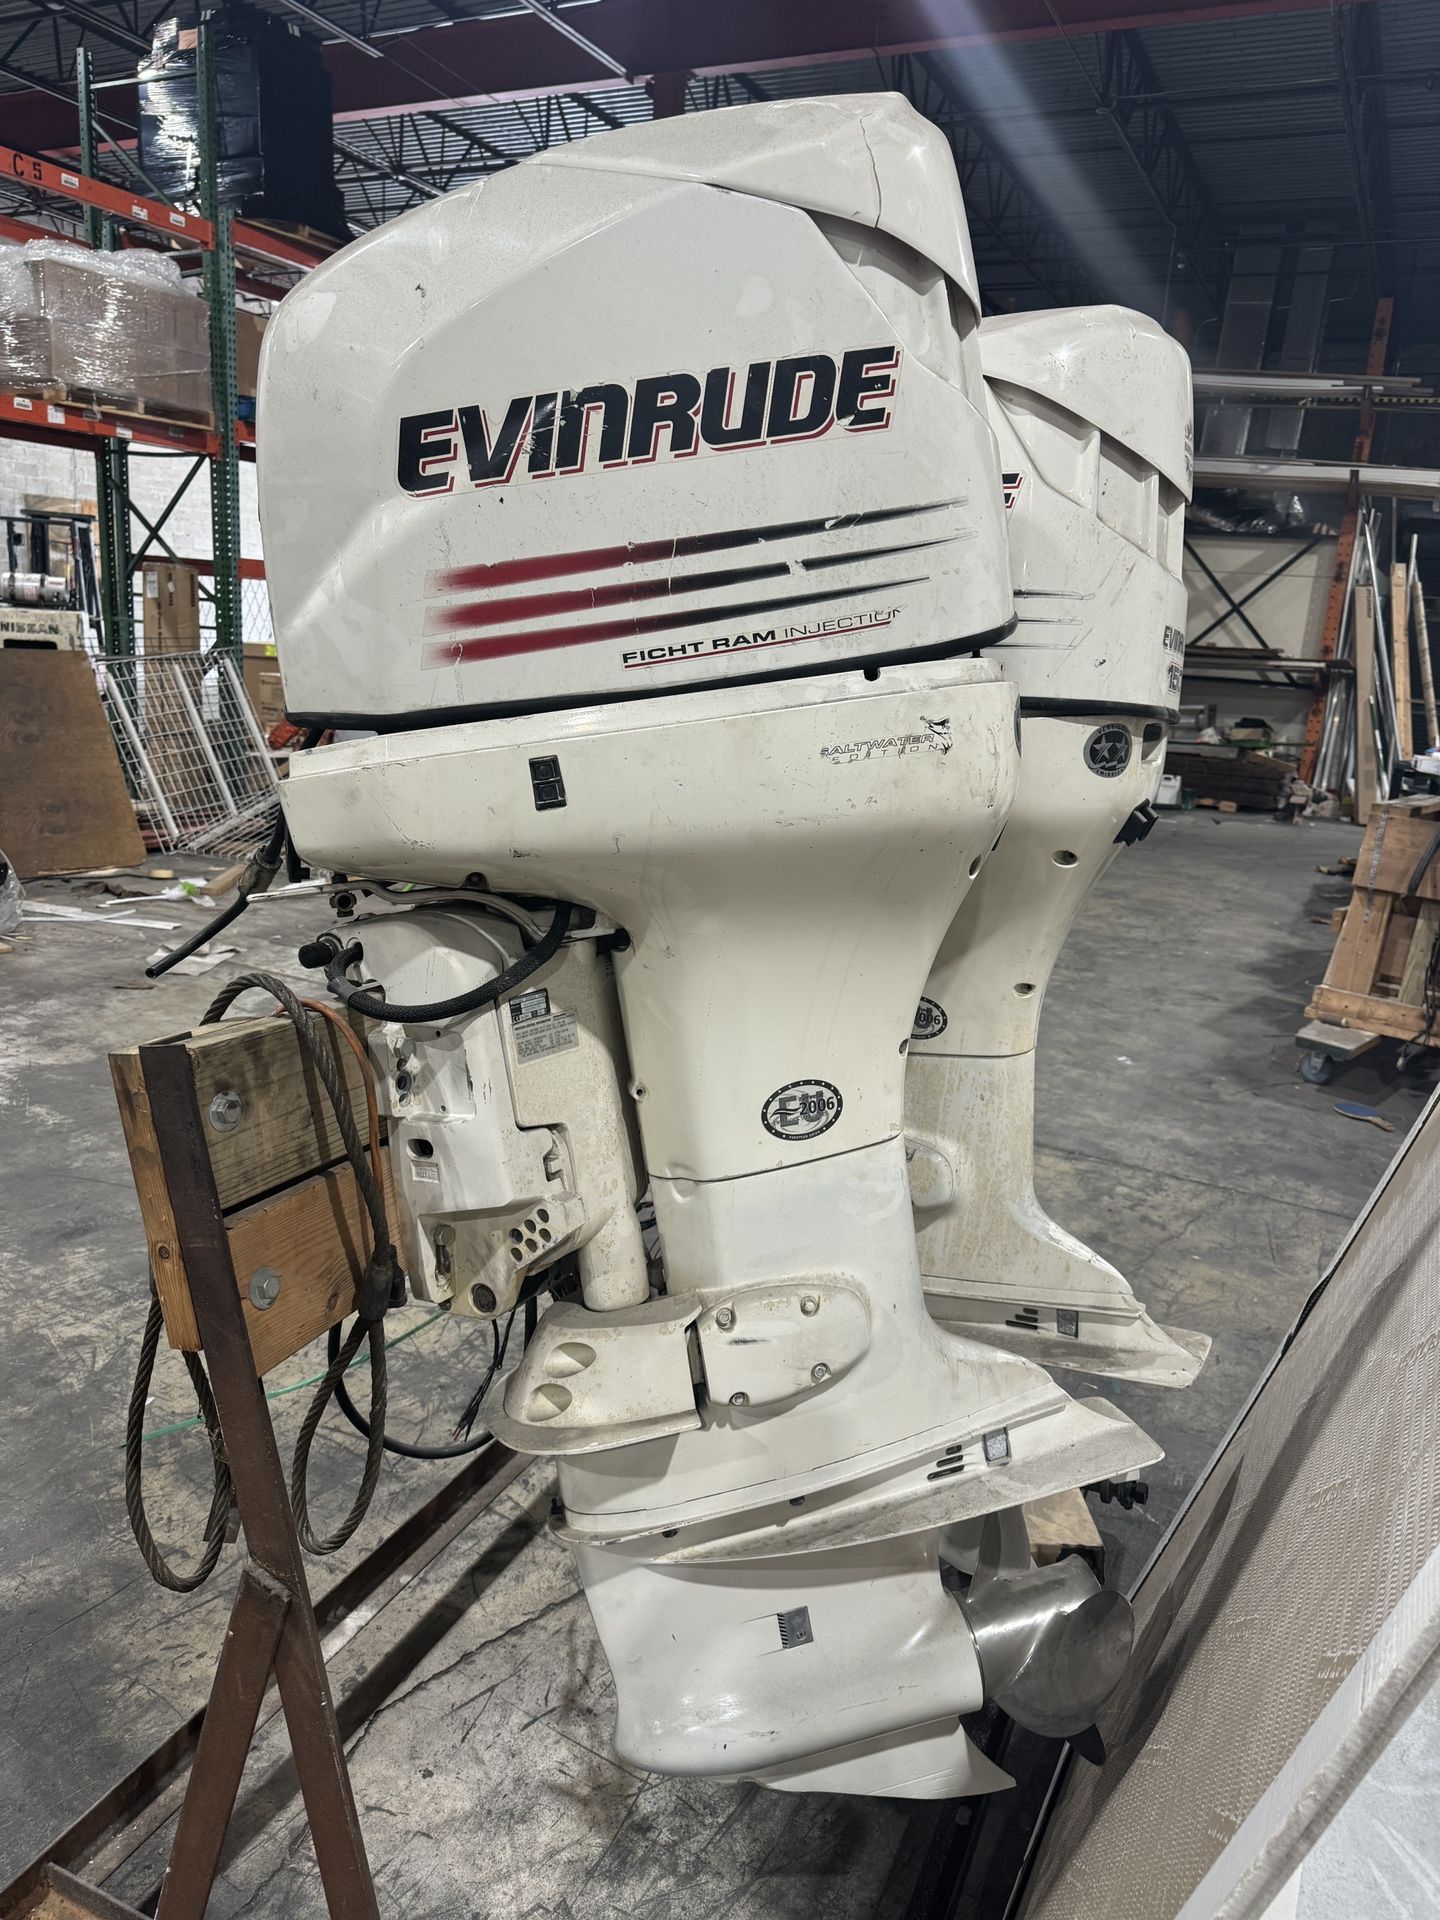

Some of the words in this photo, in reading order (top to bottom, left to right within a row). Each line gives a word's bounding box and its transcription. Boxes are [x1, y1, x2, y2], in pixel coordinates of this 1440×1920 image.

[398, 345, 900, 497] EVINRUDE
[621, 641, 704, 664] FICHT
[712, 629, 776, 650] RAM
[820, 733, 935, 756] SALTWATER
[799, 1096, 835, 1116] 2006
